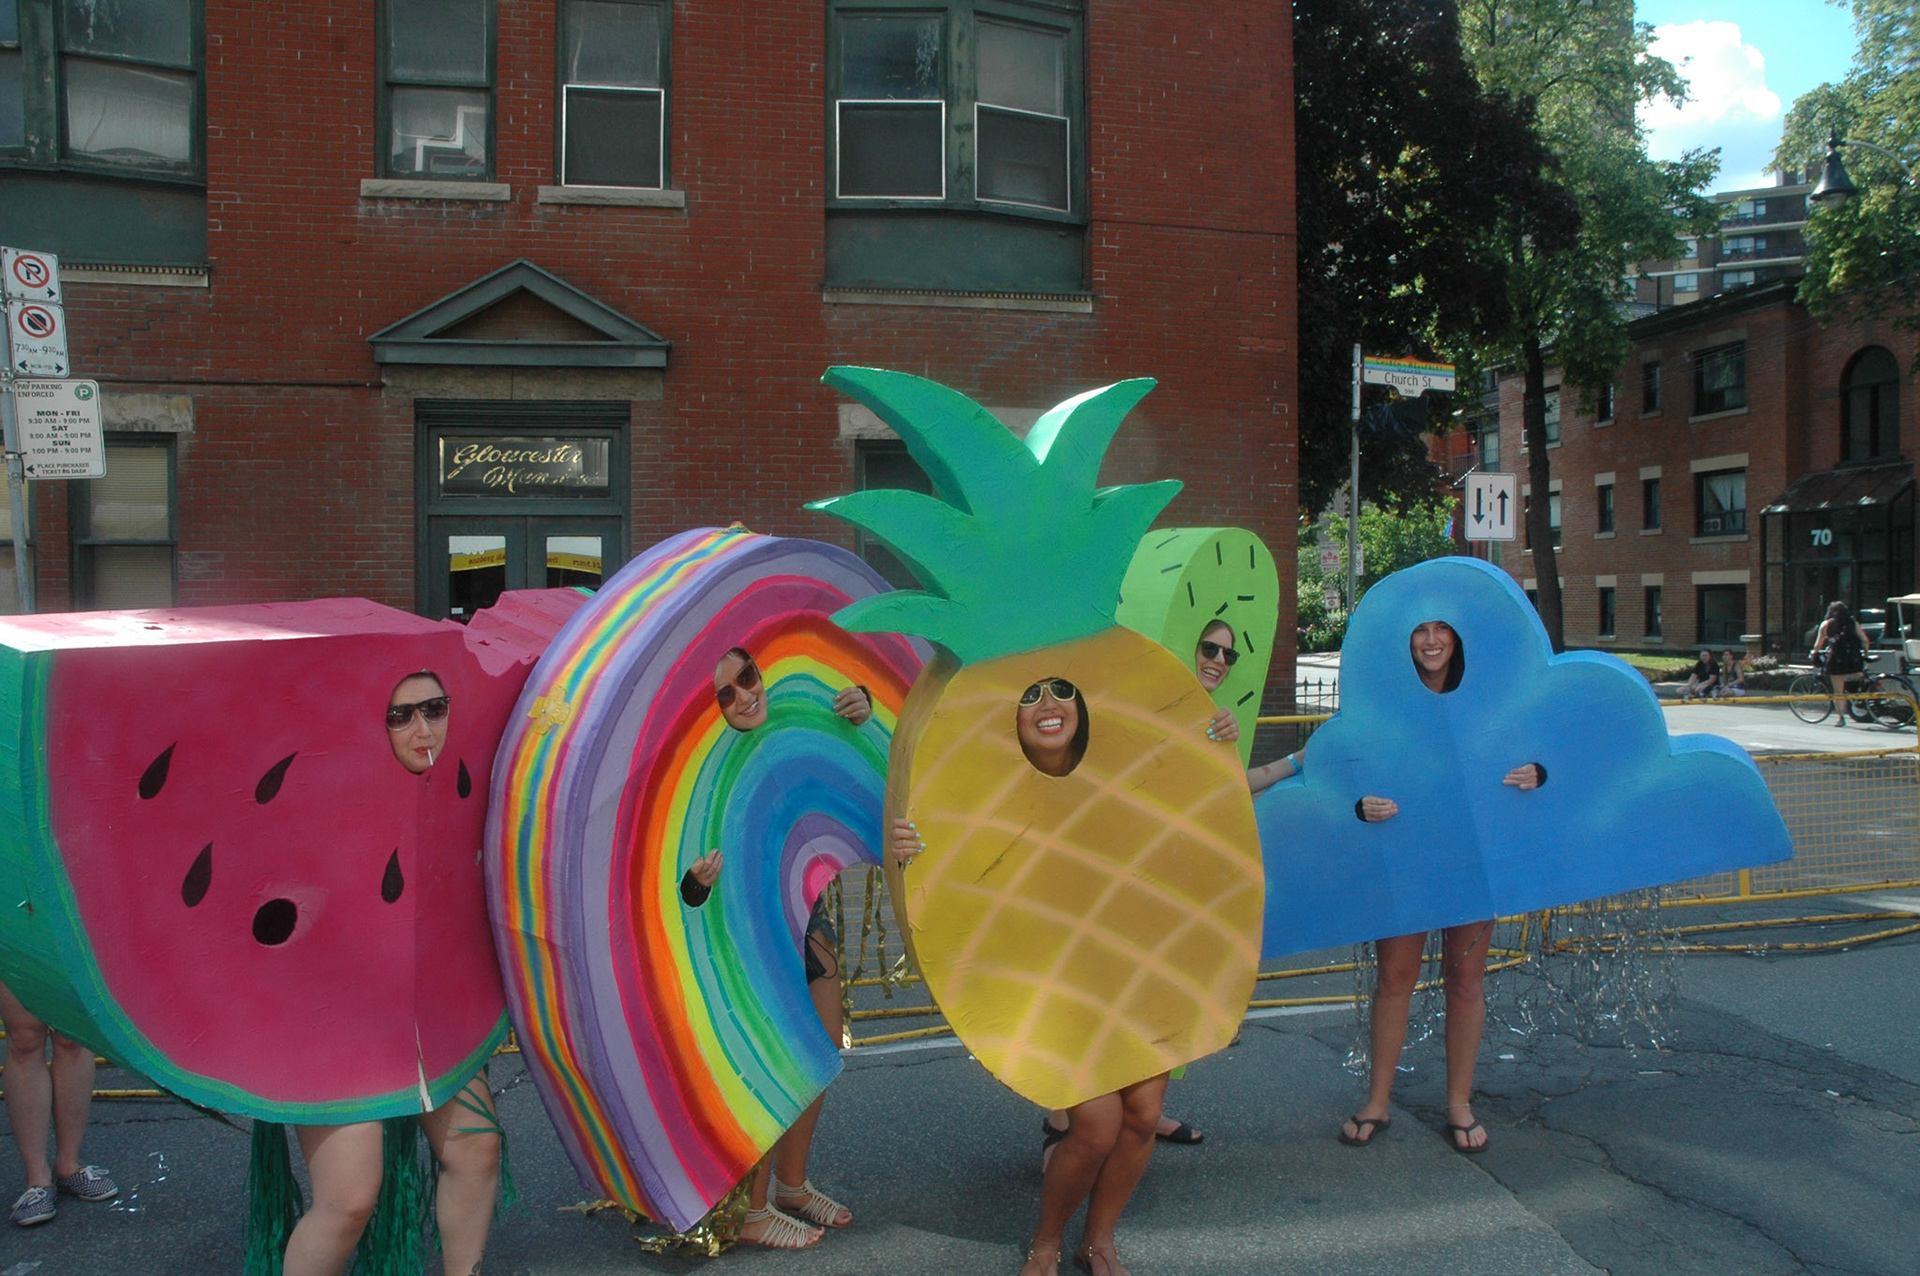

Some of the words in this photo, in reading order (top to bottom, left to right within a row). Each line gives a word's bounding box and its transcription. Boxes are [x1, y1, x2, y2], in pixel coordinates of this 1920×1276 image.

[1384, 372, 1419, 386] Church
[1422, 376, 1434, 388] St.
[447, 443, 583, 480] Gloucester
[1810, 528, 1833, 546] 70
